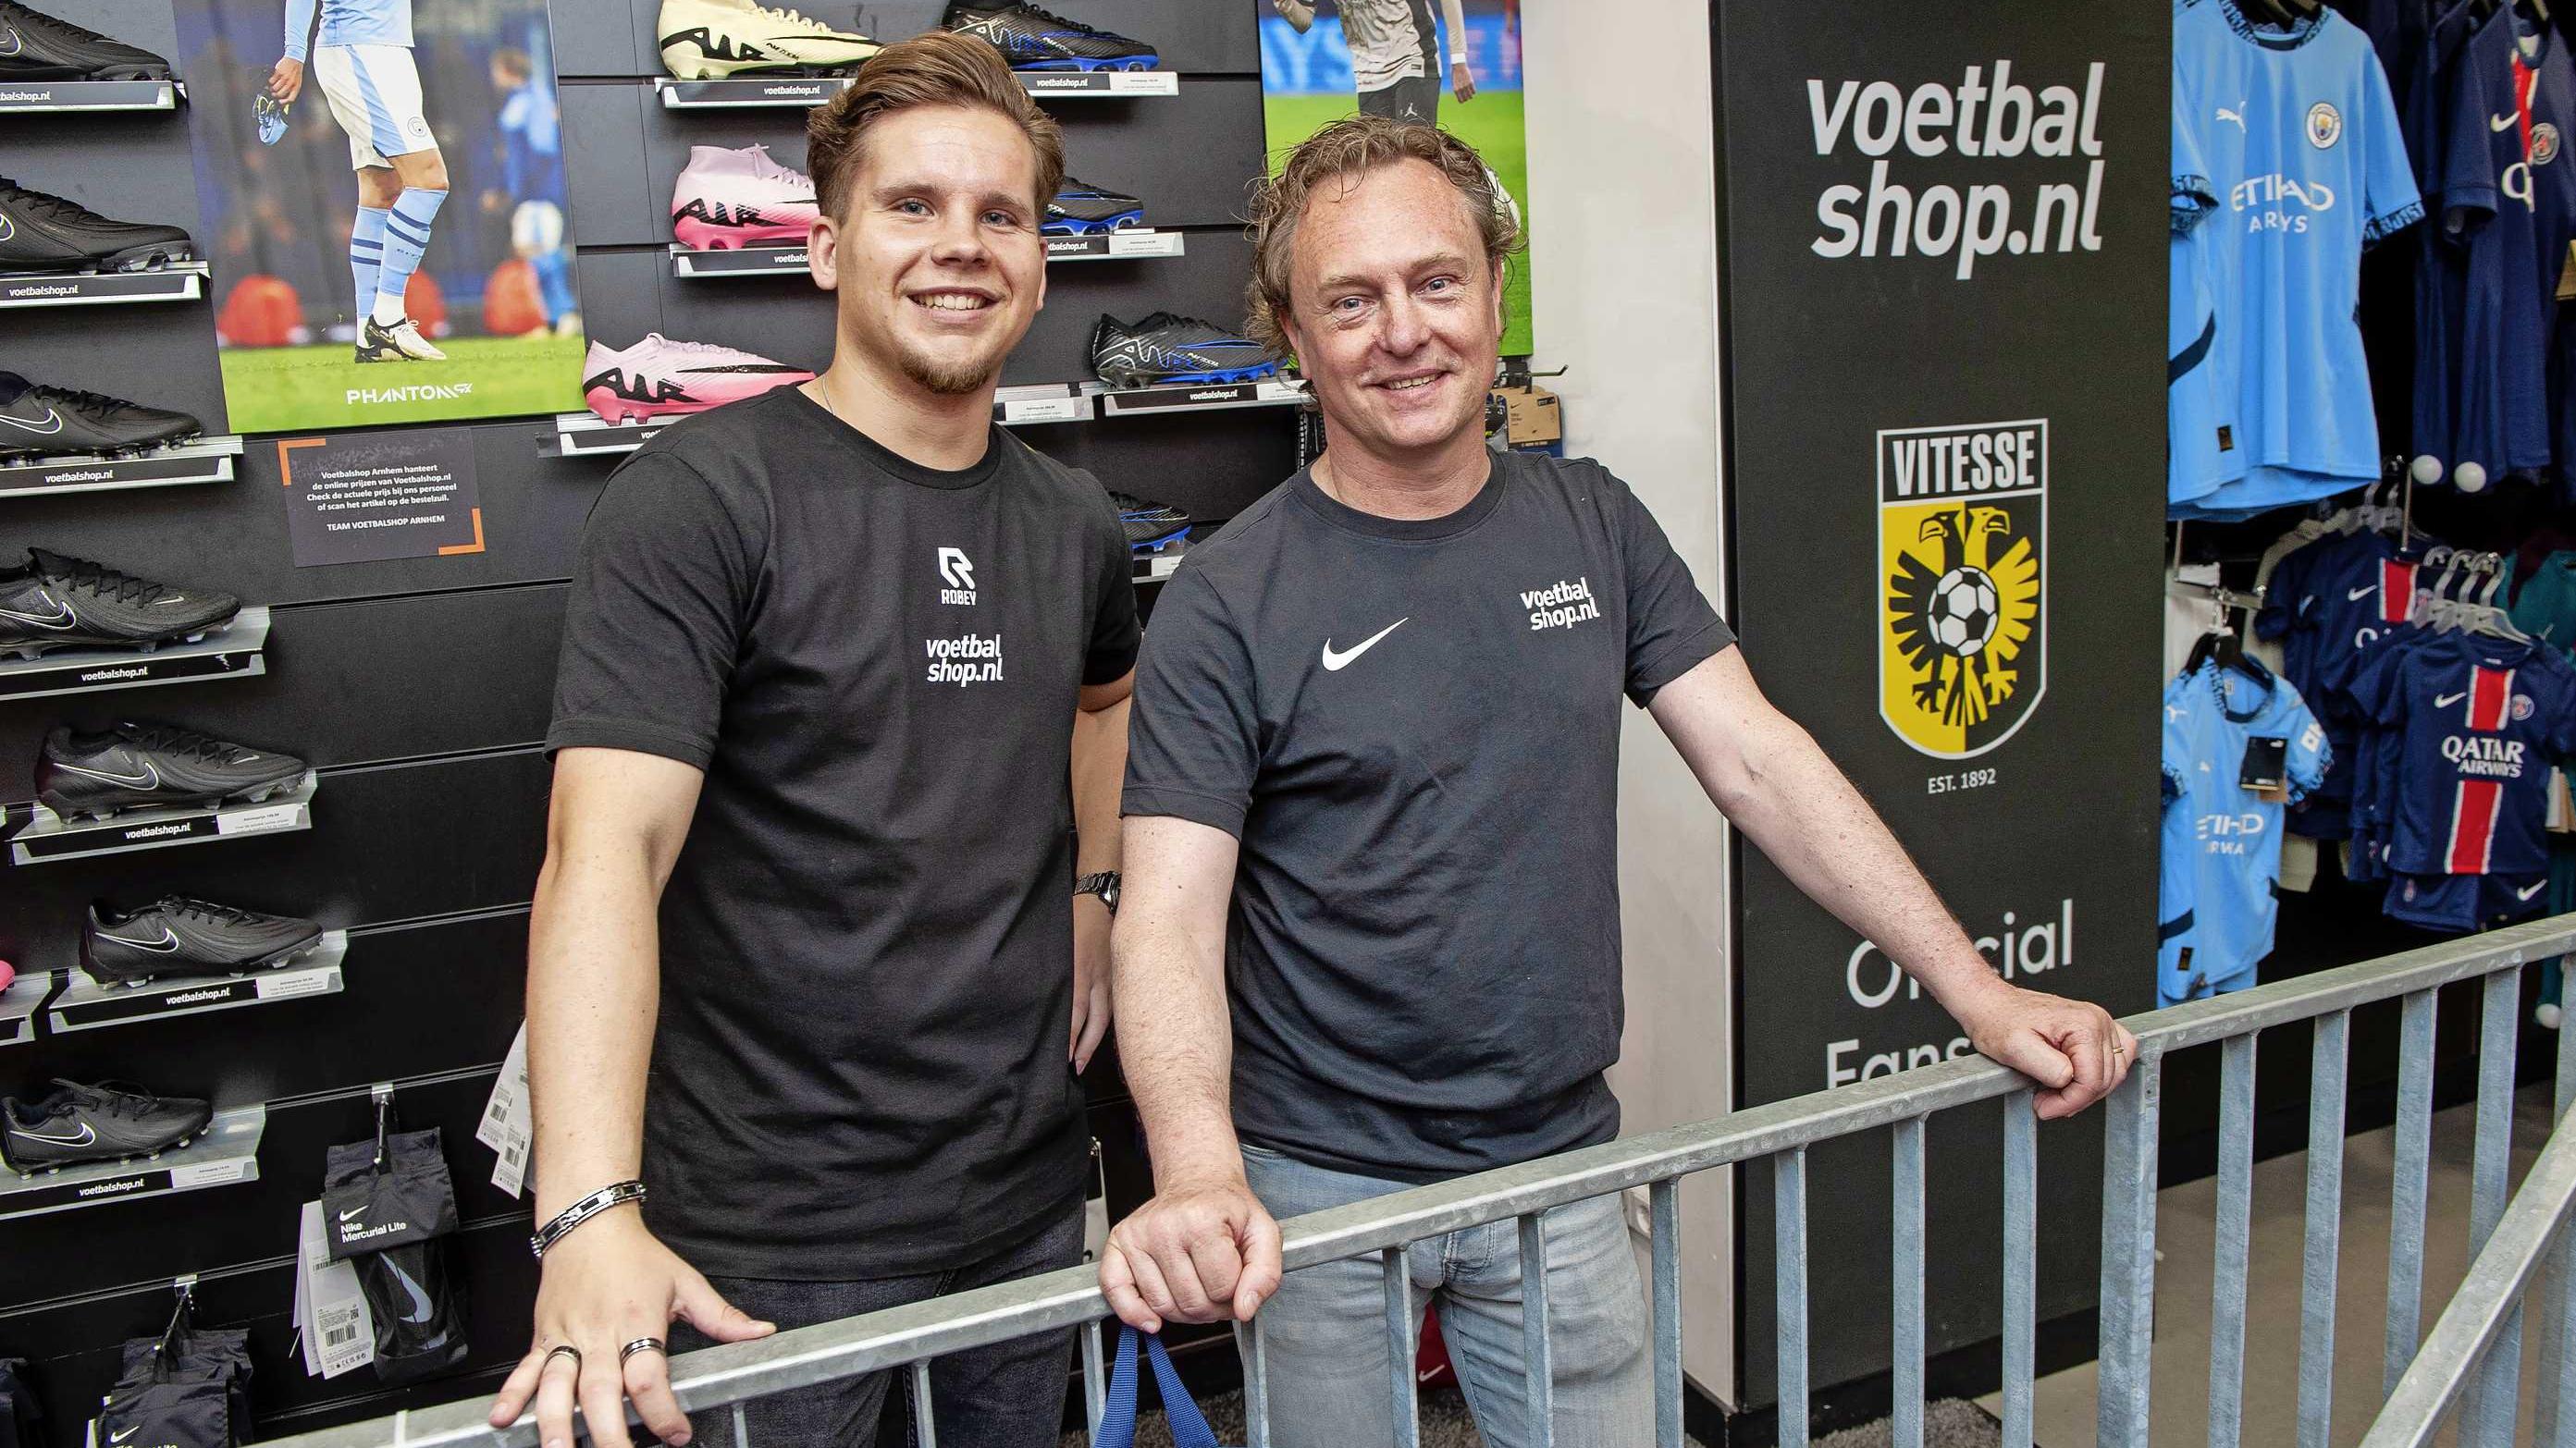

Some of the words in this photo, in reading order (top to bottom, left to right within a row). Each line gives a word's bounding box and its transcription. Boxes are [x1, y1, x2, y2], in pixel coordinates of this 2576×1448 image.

[764, 85, 820, 96] voetbalshop.nl
[1036, 78, 1089, 88] voetbalshop.nl
[0, 91, 51, 103] balshop.nl
[1806, 59, 2105, 157] voetbal
[1810, 160, 2105, 280] shop.nl
[1047, 241, 1088, 252] tbalshop.nl
[774, 253, 808, 264] voetbals
[8, 284, 79, 296] voetbalshop.nl
[1189, 389, 1238, 399] voetbalshop.nl
[321, 469, 370, 480] Voetbalshop
[372, 466, 402, 475] Arnhem
[404, 464, 438, 473] hanteert
[1892, 431, 2035, 497] VITESSE
[44, 469, 114, 483] voetbalshop.nl
[312, 482, 323, 491] de
[324, 480, 349, 490] online
[351, 478, 376, 491] prijzen
[378, 477, 393, 485] van
[394, 473, 451, 485] Voetbalshop.nl
[307, 492, 330, 501] Check
[332, 491, 342, 499] de
[343, 489, 372, 498] actuele
[374, 487, 391, 499] prijs
[392, 485, 403, 497] bij
[419, 483, 457, 496] personeel
[317, 502, 327, 511] of
[327, 502, 345, 510] scan
[347, 499, 360, 509] het
[361, 497, 387, 508] artikel
[388, 498, 398, 508] op
[400, 496, 409, 505] de
[411, 494, 450, 504] bestelzuil.
[327, 522, 351, 532] TEAM
[351, 518, 409, 530] VOETBALSHOP
[410, 515, 445, 524] ARNHEM
[941, 589, 977, 606] ROBEY
[1520, 577, 1592, 609] voetbal
[1530, 596, 1600, 631] shop.nl
[926, 633, 1002, 658] voetbal
[81, 666, 148, 681] voetbalshop.nl
[927, 657, 1004, 687] shop.nl
[2442, 735, 2525, 764] QATAR
[1928, 777, 1956, 794] EST.
[1961, 768, 1997, 790] 1892
[125, 822, 191, 839] voetbalshop.nl
[166, 987, 230, 1005] voetbalshop.nl
[79, 1179, 144, 1196] voetbalshop.nl
[340, 1221, 363, 1234] Nike
[341, 1224, 388, 1244] Mercurial
[388, 1221, 407, 1233] Lite
